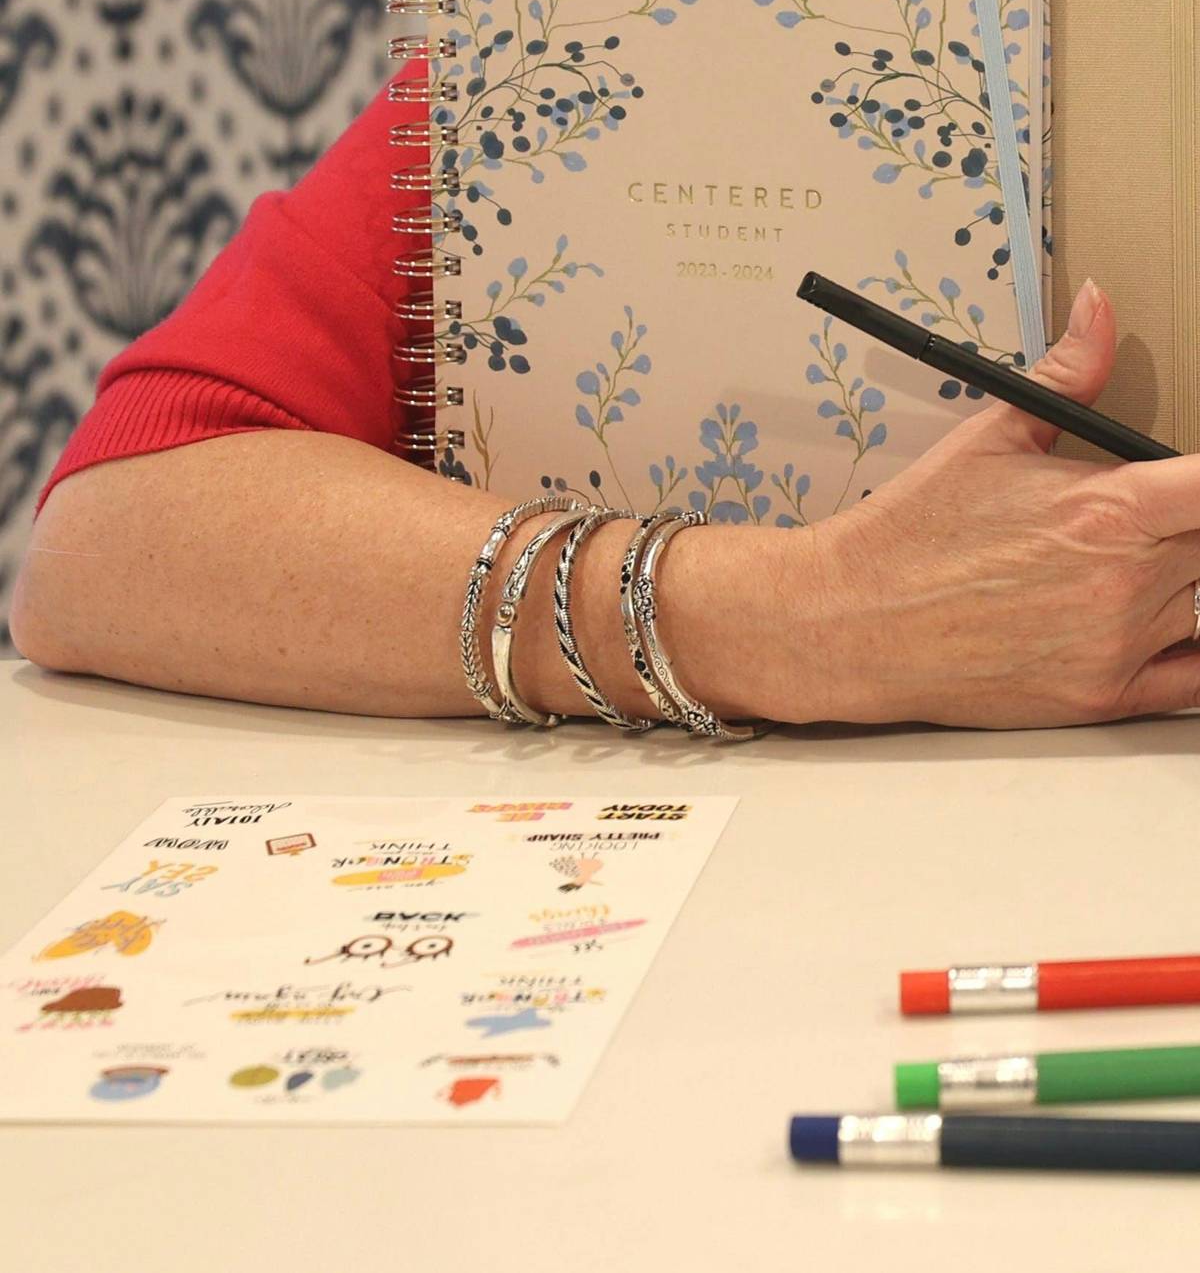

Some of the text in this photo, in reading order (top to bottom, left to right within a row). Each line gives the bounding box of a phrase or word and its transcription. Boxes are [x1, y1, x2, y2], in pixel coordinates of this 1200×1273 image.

[627, 182, 823, 210] CENTERED
[666, 223, 784, 243] STUDENT
[600, 804, 690, 813] TODAY
[599, 812, 688, 822] START
[526, 832, 662, 842] PRETTY SHARP
